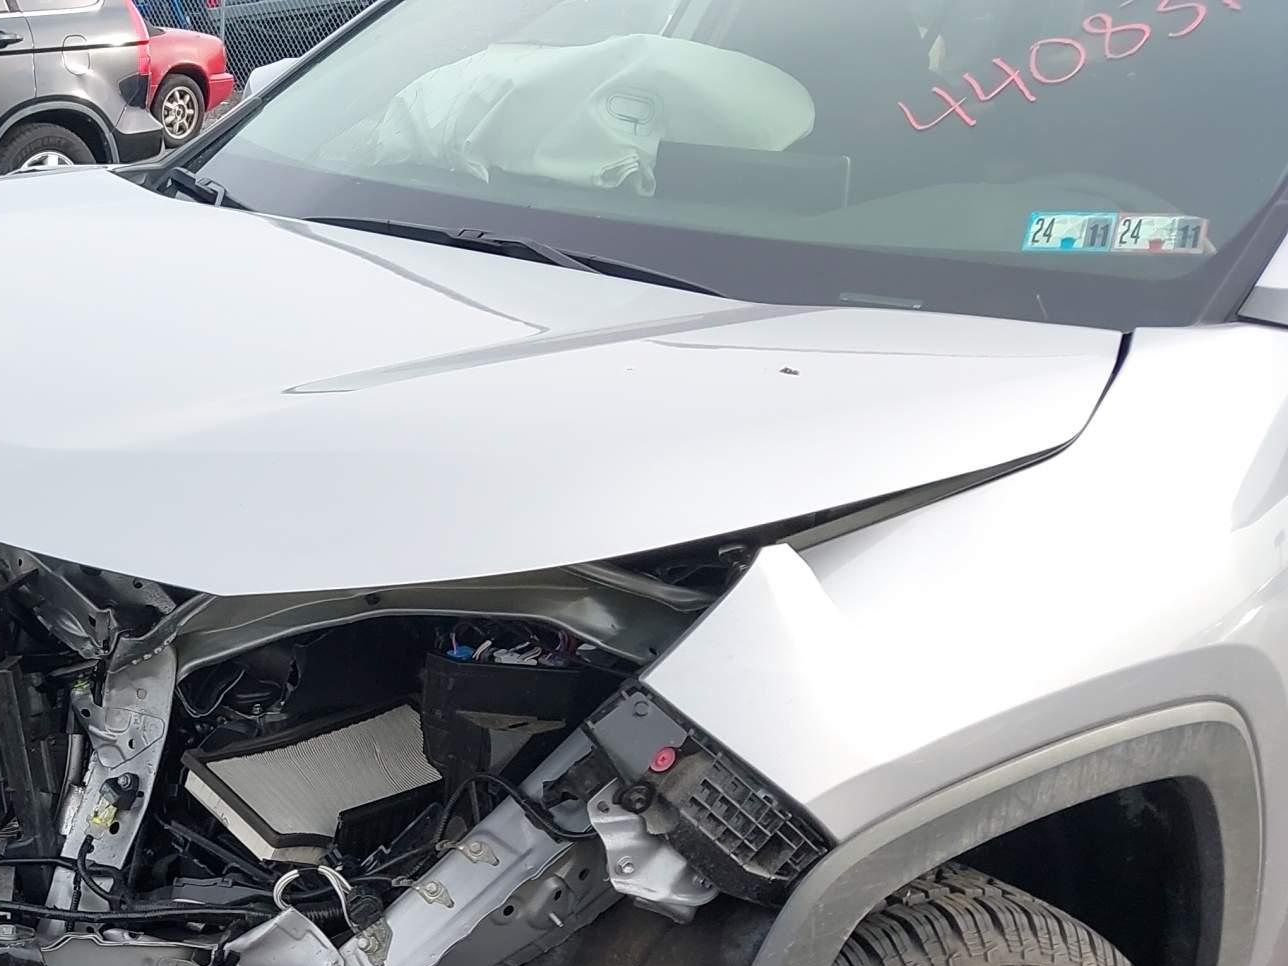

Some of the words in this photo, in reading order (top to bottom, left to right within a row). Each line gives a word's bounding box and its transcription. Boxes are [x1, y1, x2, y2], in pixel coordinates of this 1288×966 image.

[897, 0, 1242, 131] 44083
[1031, 217, 1056, 244] 24
[1088, 223, 1110, 247] 11
[1118, 218, 1143, 245] 24
[1178, 224, 1202, 249] 11
